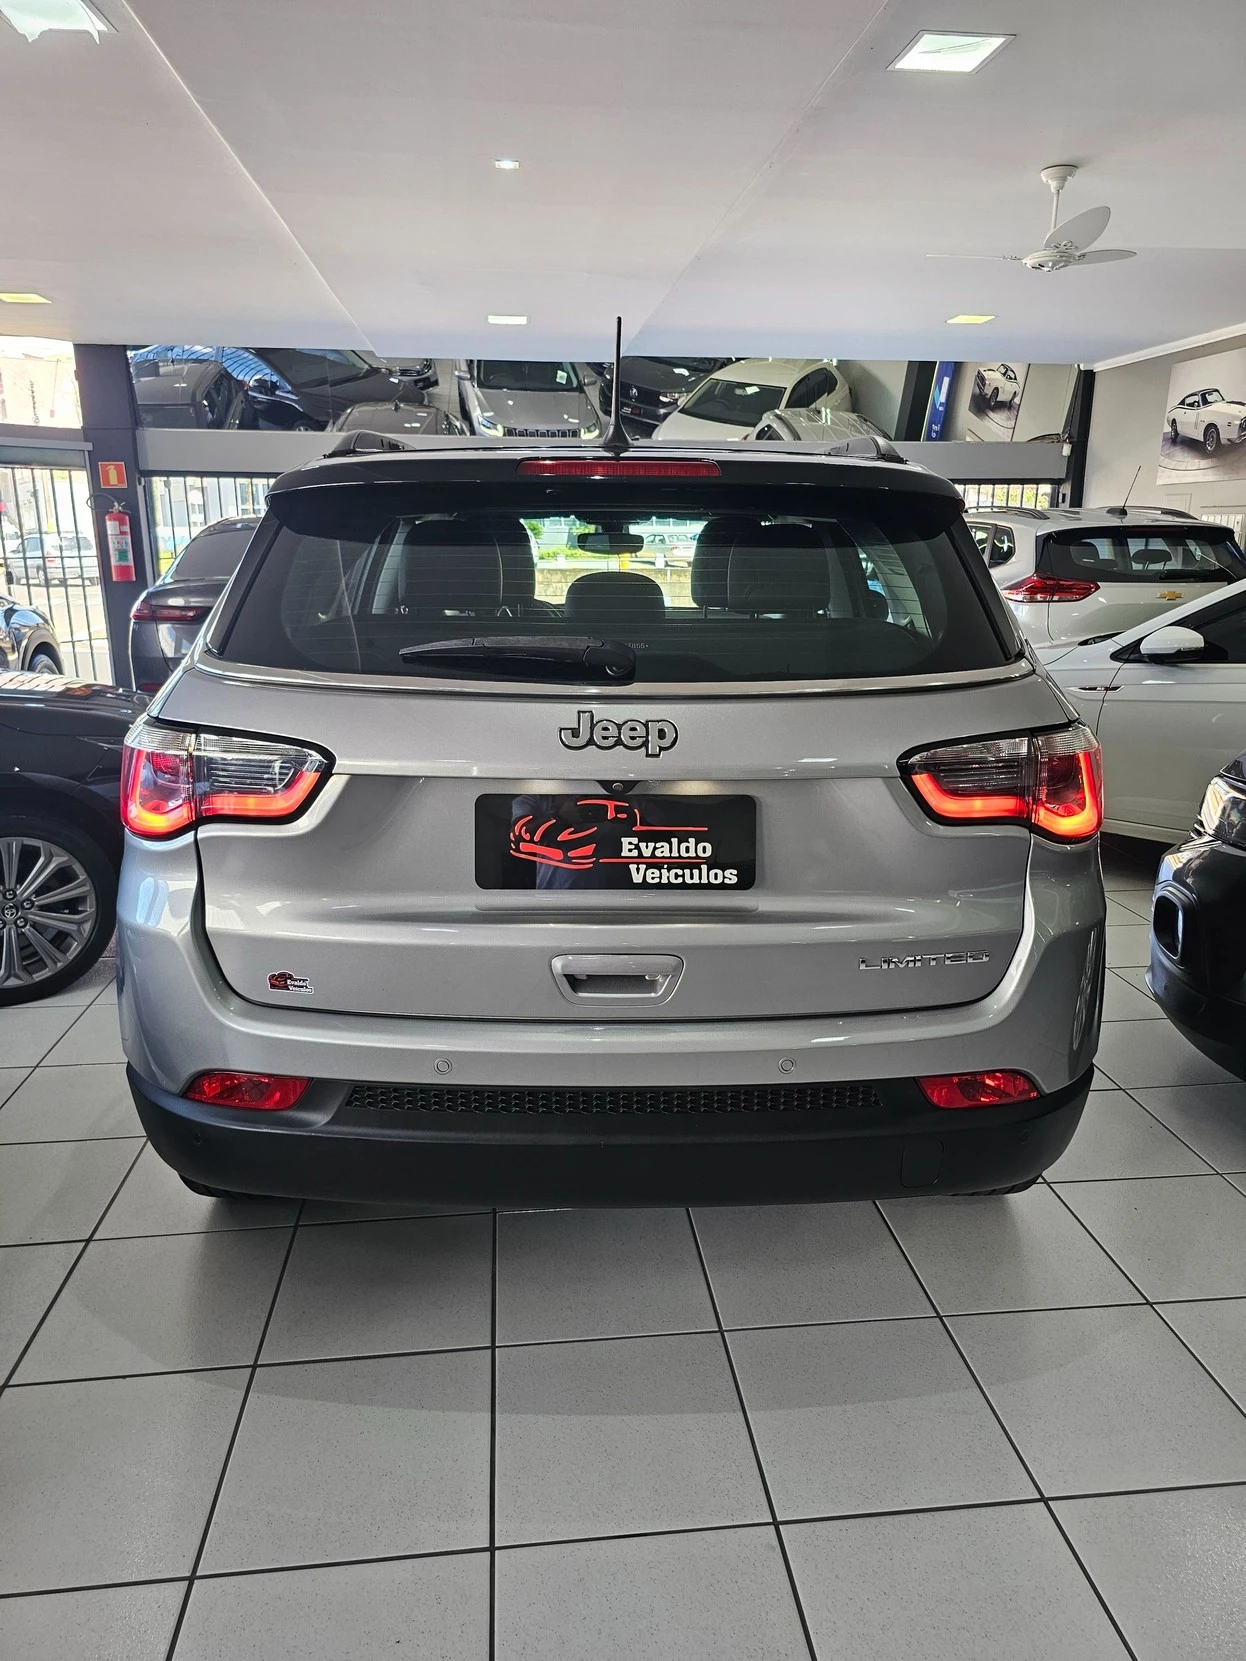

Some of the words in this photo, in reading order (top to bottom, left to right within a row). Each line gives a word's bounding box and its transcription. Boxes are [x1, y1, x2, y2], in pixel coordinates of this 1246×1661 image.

[559, 710, 678, 758] Jeep
[621, 837, 712, 857] Evaldo
[629, 864, 738, 884] Veículos
[859, 950, 990, 970] LIMITED
